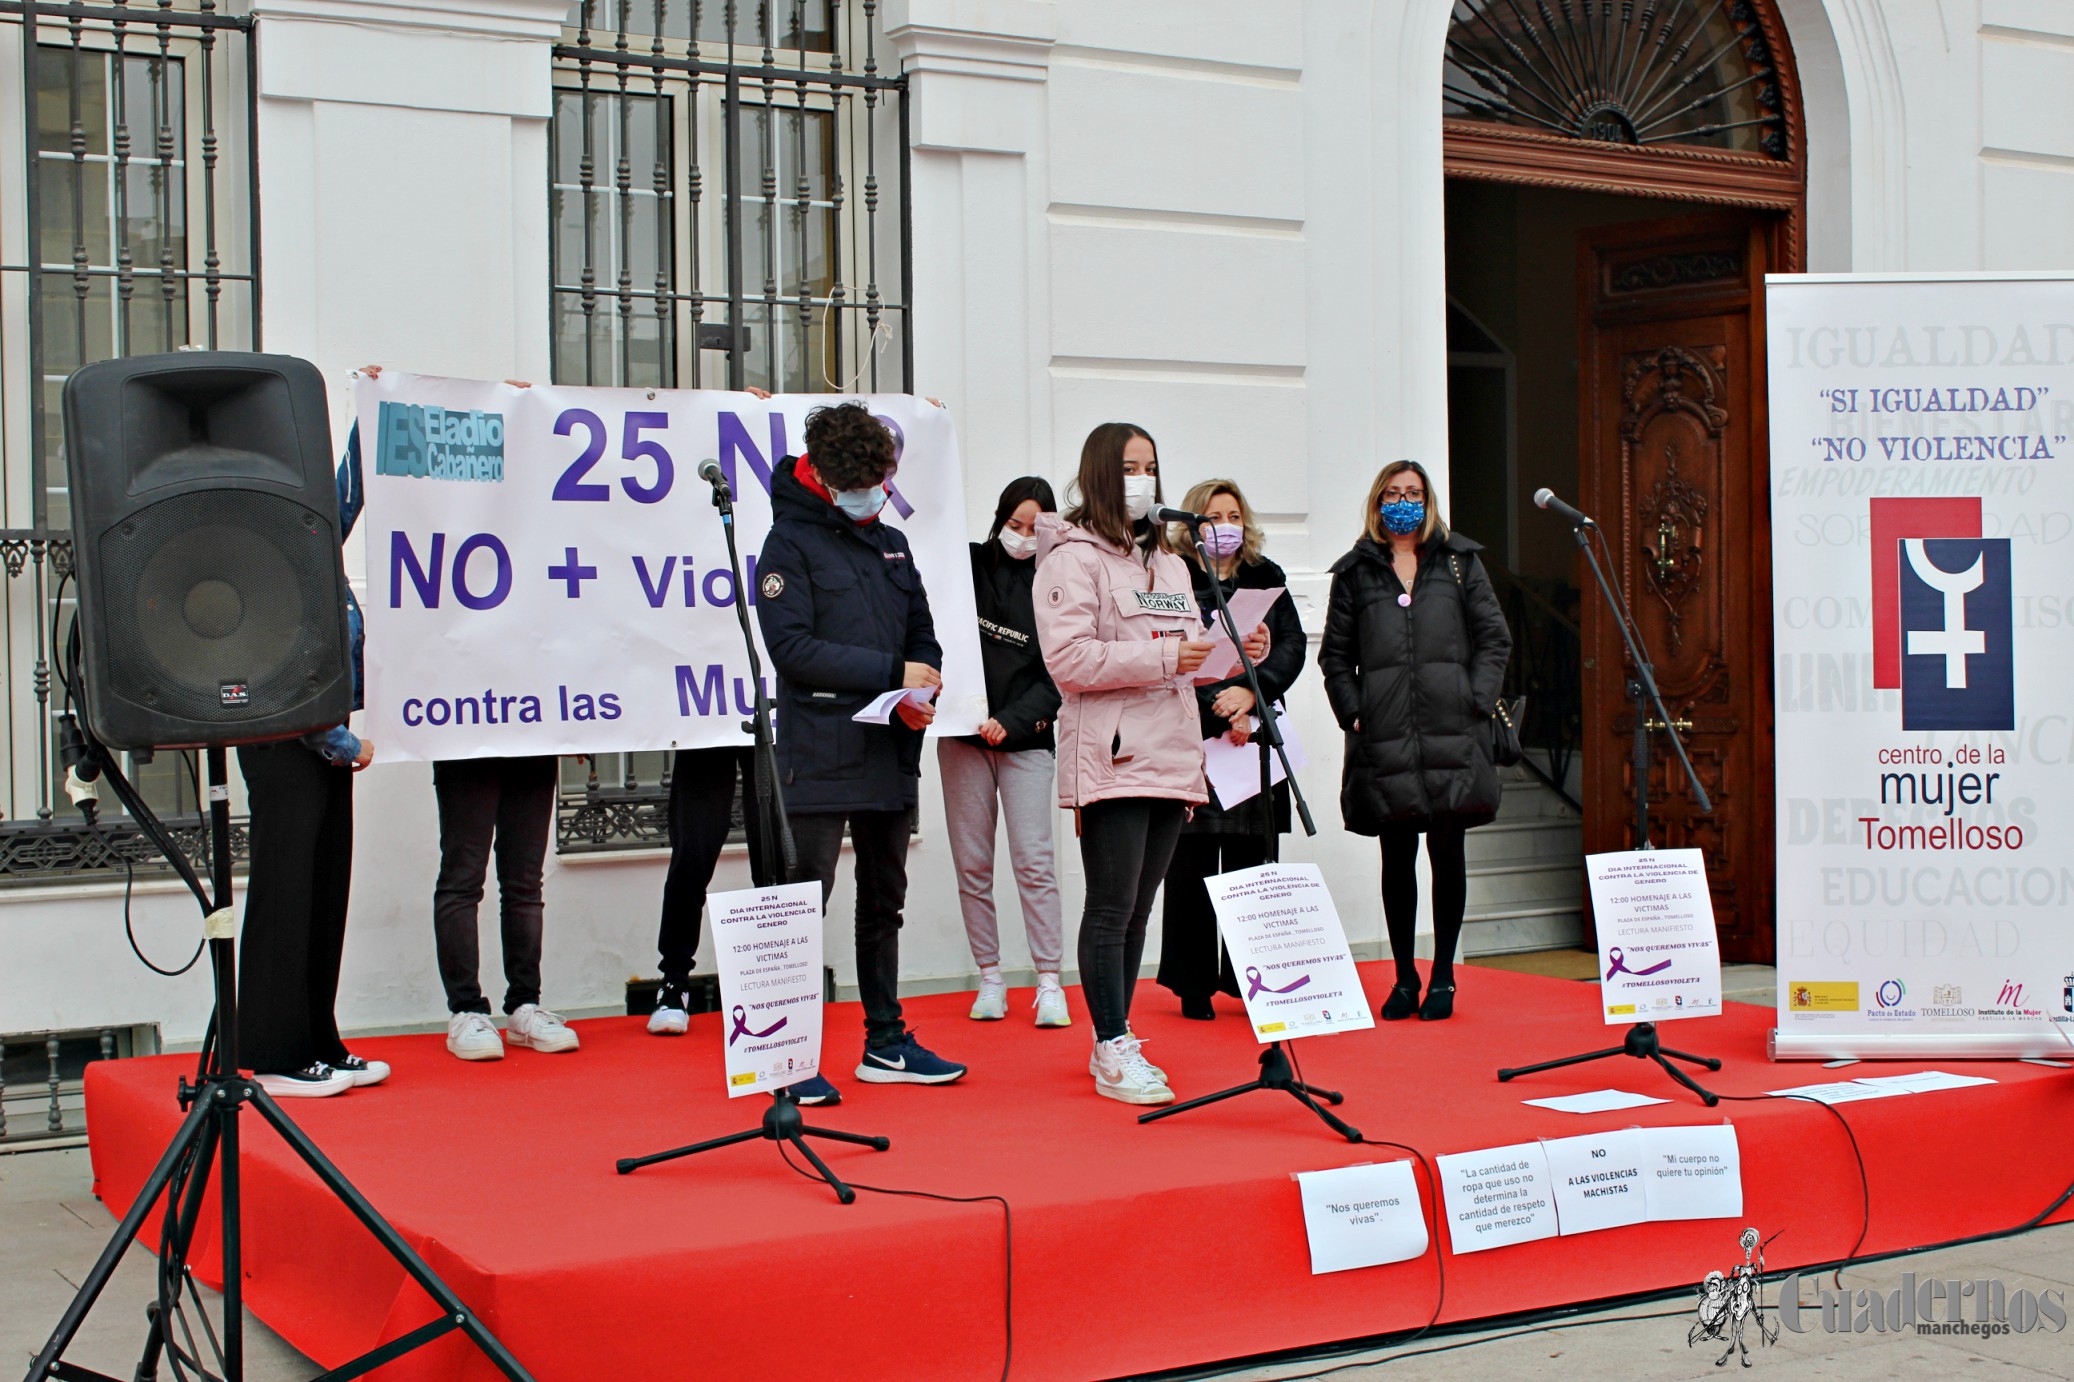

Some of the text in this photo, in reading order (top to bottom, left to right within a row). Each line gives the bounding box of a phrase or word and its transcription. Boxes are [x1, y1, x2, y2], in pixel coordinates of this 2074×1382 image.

[424, 405, 504, 446] Eladio
[376, 401, 428, 479] IES
[428, 442, 504, 482] Cabañero
[552, 408, 675, 504] 25
[1778, 464, 2038, 498] EMPODERAMIENTO
[390, 531, 513, 611] NO
[547, 547, 598, 599] +
[998, 626, 1028, 642] REPUBLIC
[403, 686, 622, 727] contra las
[1878, 744, 2005, 765] centro de la
[1880, 761, 1999, 816] mujer
[1858, 817, 2023, 850] Tomelloso
[1246, 877, 1309, 888] INTERNACIONAL
[1221, 889, 1255, 900] CONTRA
[1270, 884, 1309, 892] VIOLENCIA
[1259, 892, 1292, 900] GENERO
[1610, 896, 1629, 904] 12:00
[1631, 894, 1670, 902] HOMENAJE
[745, 900, 808, 913] INTERNACIONAL
[1634, 904, 1669, 912] VICTIMAS
[720, 915, 755, 924] CONTRA
[768, 909, 806, 919] VIOLENCIA
[1237, 913, 1257, 923] 12:00
[1258, 908, 1298, 919] HOMENAJE
[757, 920, 787, 929] GENERO
[1263, 919, 1298, 929] VICTIMAS
[1295, 927, 1324, 935] TOMELLOSO
[1618, 924, 1693, 936] LECTURA MANIFIESTO
[733, 943, 752, 953] 12:00
[753, 939, 790, 951] HOMENAJE
[797, 936, 808, 944] LAS
[1250, 938, 1325, 954] LECTURA MANIFIESTO
[1645, 943, 1686, 952] QUEREMOS
[1786, 918, 2021, 965] EQUIDAD
[756, 951, 788, 963] VICTIMAS
[1282, 958, 1321, 969] QUEREMOS
[783, 962, 808, 970] TOMELLOSO
[740, 974, 807, 991] LECTURA MANIFIESTO
[766, 997, 800, 1010] QUEREMOS
[1894, 1009, 1916, 1017] Estado
[1921, 1008, 1974, 1017] TOMELLOSO
[1591, 1148, 1607, 1159] NO
[1662, 1154, 1719, 1168] "Mi cuerpo no
[1460, 1160, 1530, 1179] "La cantidad de
[1568, 1168, 1638, 1186] A LAS VIOLENCIAS
[1656, 1165, 1728, 1179] quiere tu opinión"
[1462, 1174, 1534, 1194] ropa que uso no
[1583, 1184, 1628, 1199] MACHISTAS
[1473, 1187, 1528, 1205] determina la
[1325, 1196, 1400, 1215] "Nos queremos
[1458, 1198, 1546, 1221] cantidad de respeto
[1475, 1213, 1535, 1233] que merezco"
